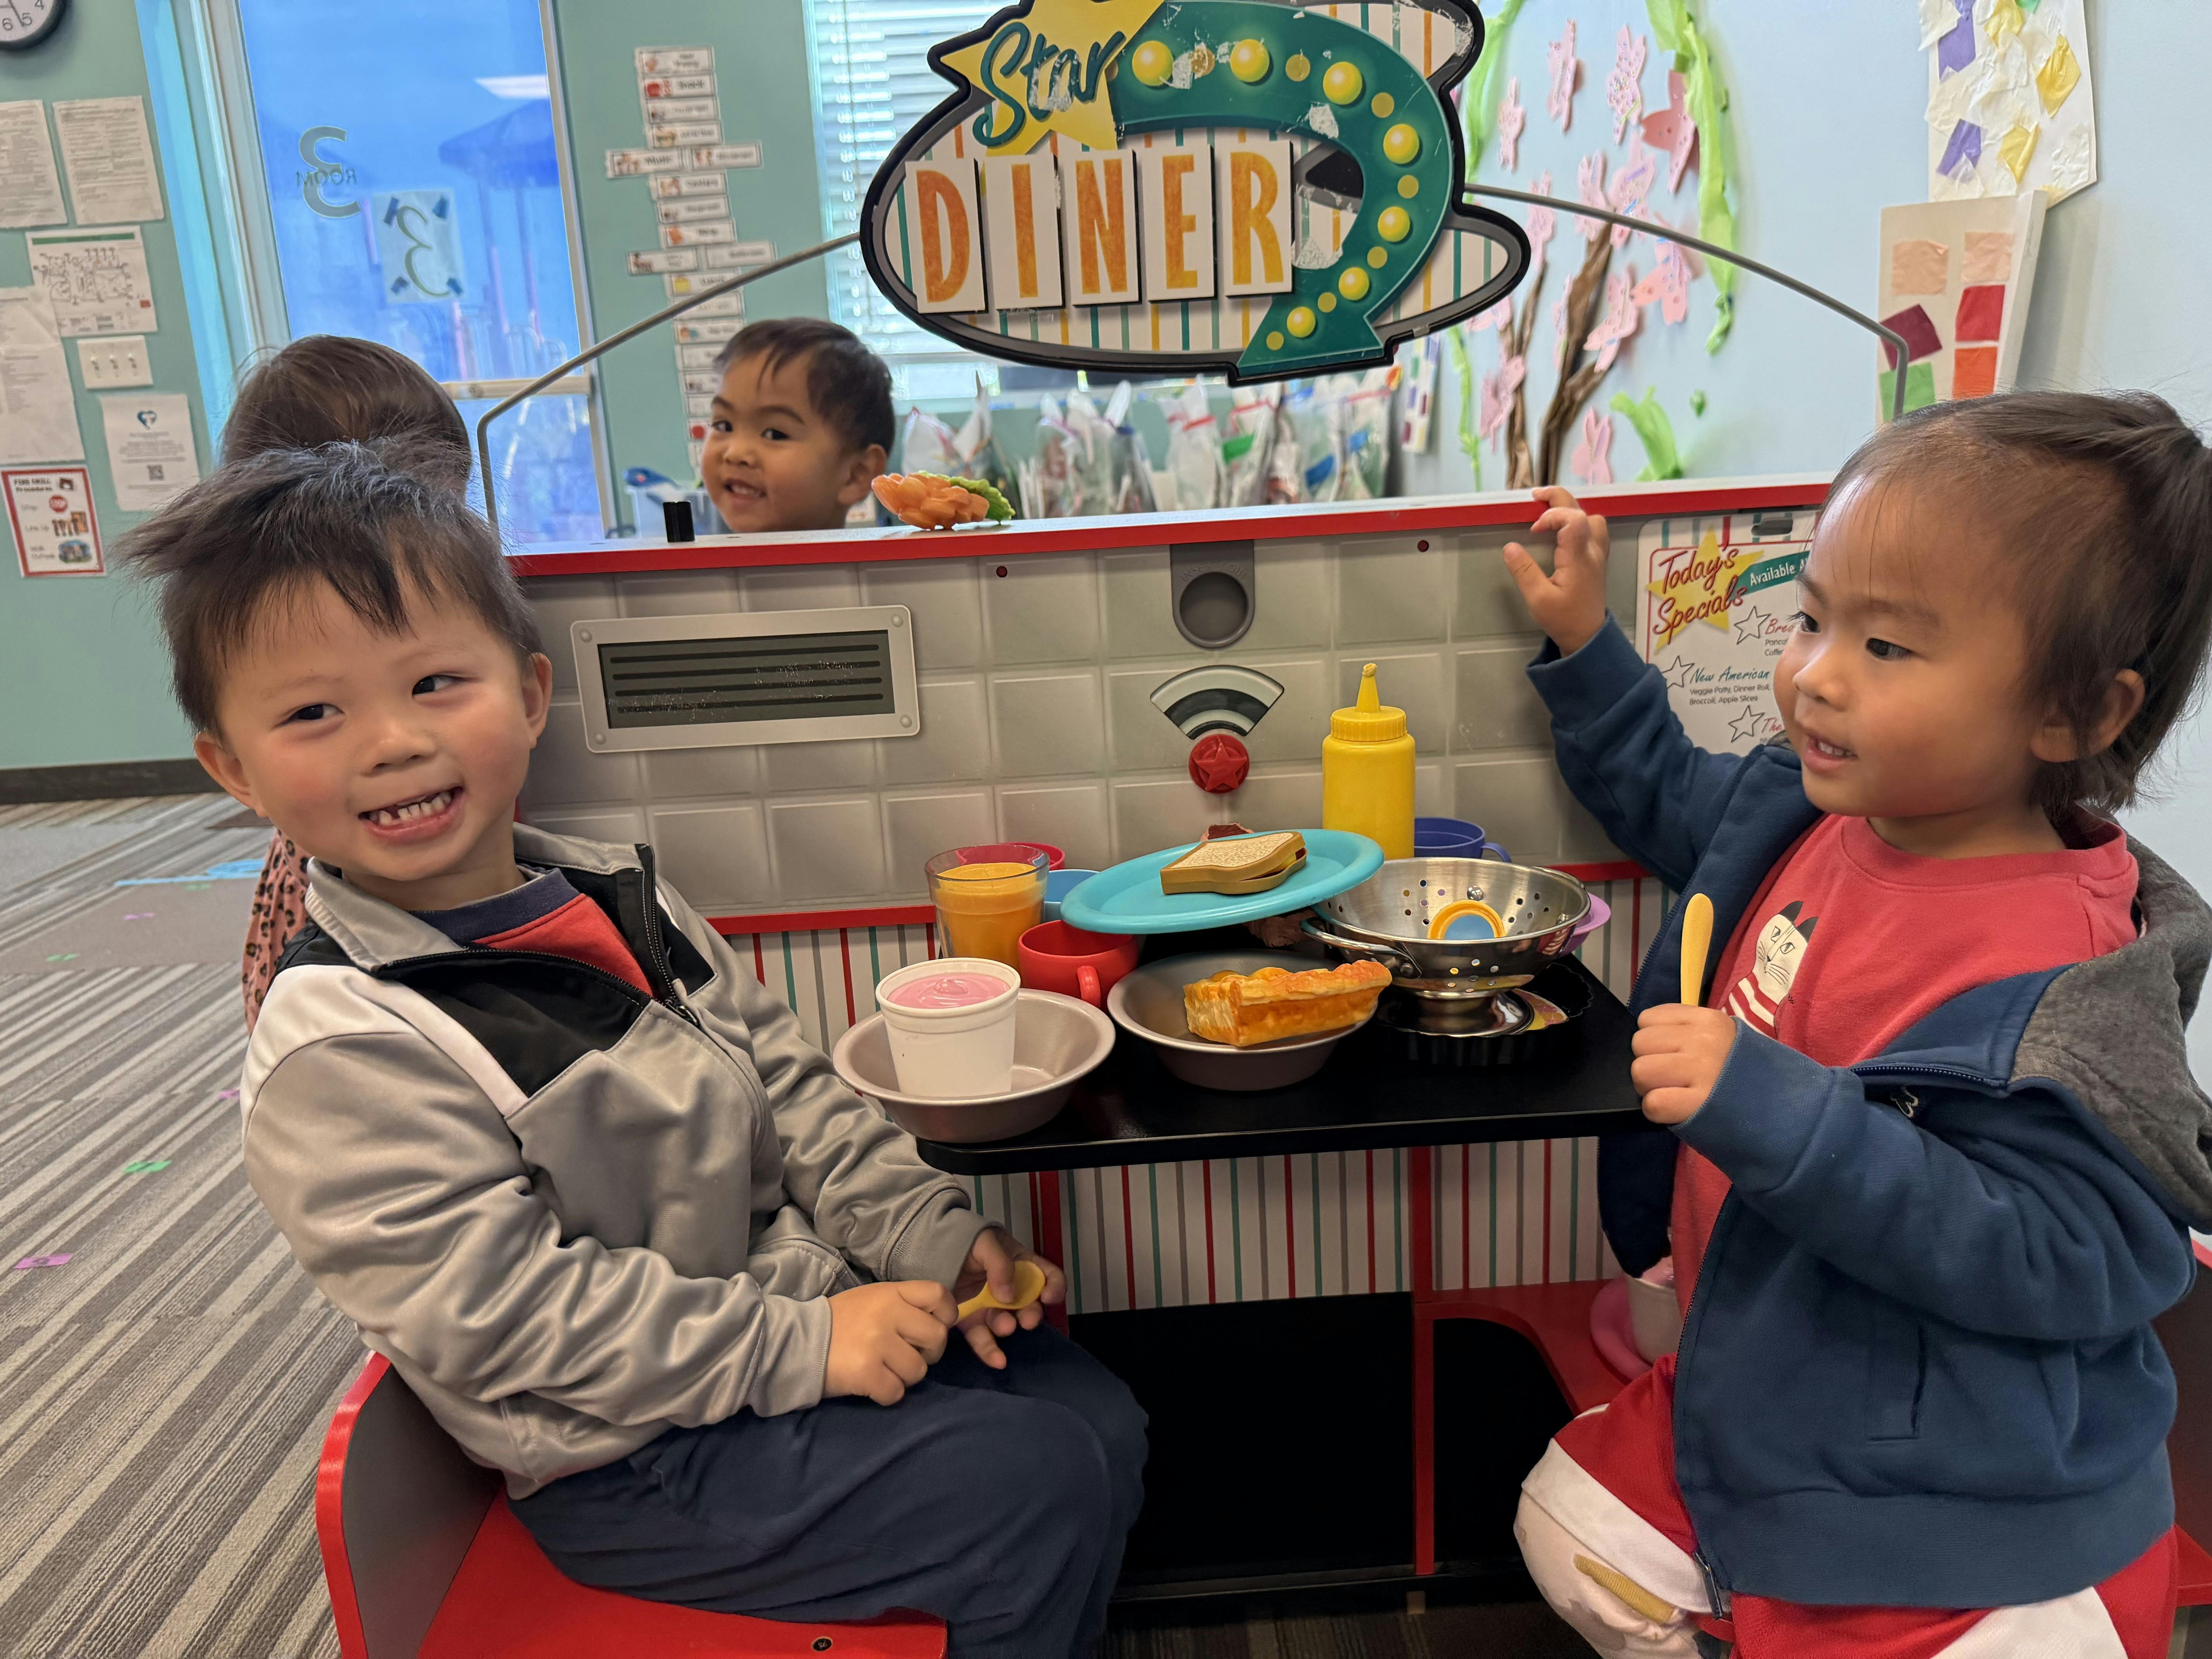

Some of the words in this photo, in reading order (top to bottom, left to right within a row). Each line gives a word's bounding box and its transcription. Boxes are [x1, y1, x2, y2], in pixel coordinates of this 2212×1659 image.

[2, 18, 13, 31] 6
[21, 13, 33, 26] 5
[972, 22, 1125, 147] Star
[916, 151, 1284, 303] DINER
[1658, 548, 1738, 594] Today's
[1750, 562, 1795, 586] Available
[1652, 574, 1747, 645] Specials
[1690, 667, 1714, 684] New
[1718, 666, 1770, 682] American
